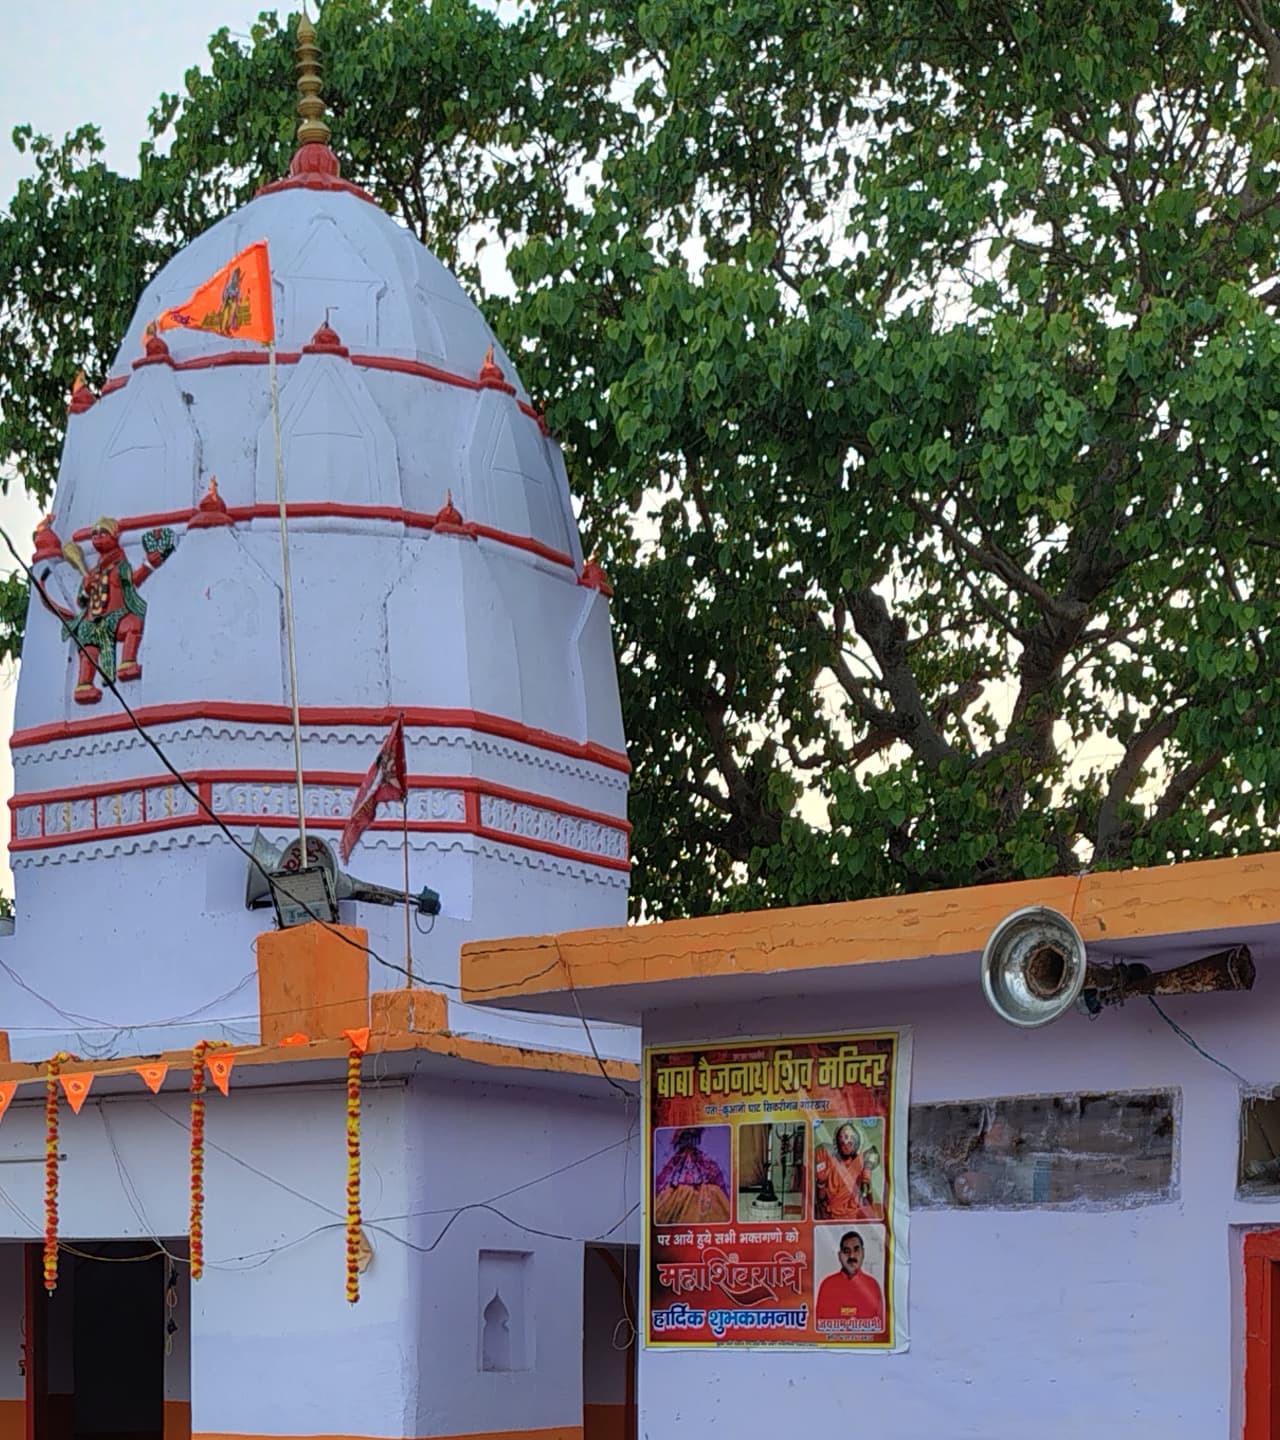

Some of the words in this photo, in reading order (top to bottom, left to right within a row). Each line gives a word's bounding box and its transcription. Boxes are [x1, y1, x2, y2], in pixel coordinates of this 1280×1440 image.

[657, 1065, 694, 1098] बाबा
[698, 1056, 769, 1096] बैजनाथ
[774, 1049, 813, 1092] शिव
[818, 1045, 888, 1089] मन्दिर
[657, 1234, 670, 1246] पर
[715, 1230, 736, 1244] सभी
[785, 1227, 799, 1242] को
[653, 1304, 704, 1330] हार्दिक
[708, 1305, 808, 1336] शुभकामनाएं
